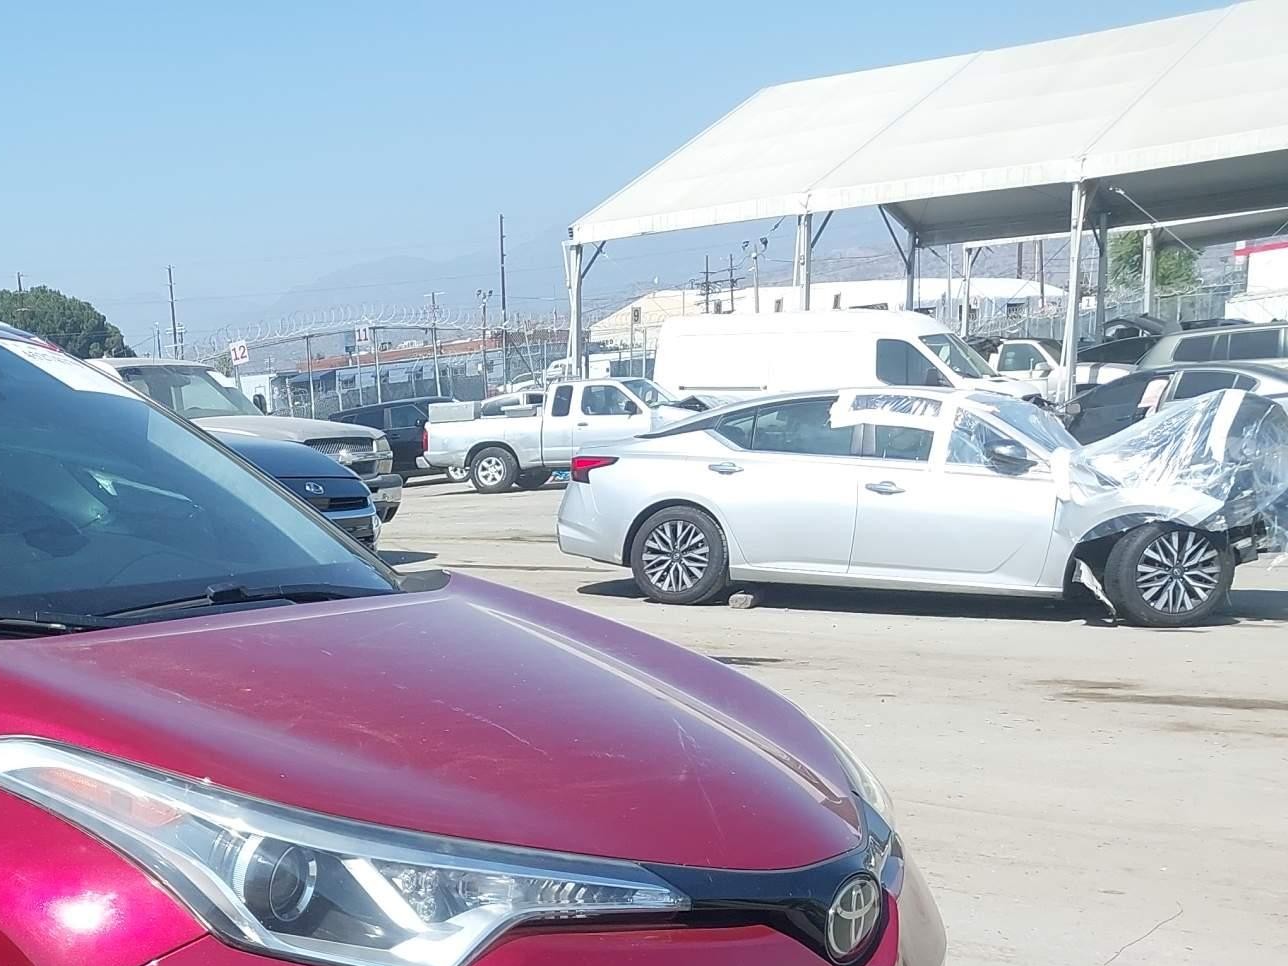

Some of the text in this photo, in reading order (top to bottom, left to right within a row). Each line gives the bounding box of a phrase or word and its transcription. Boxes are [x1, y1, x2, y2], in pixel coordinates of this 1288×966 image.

[632, 309, 640, 323] 9
[356, 328, 369, 342] 11
[231, 344, 248, 361] 12
